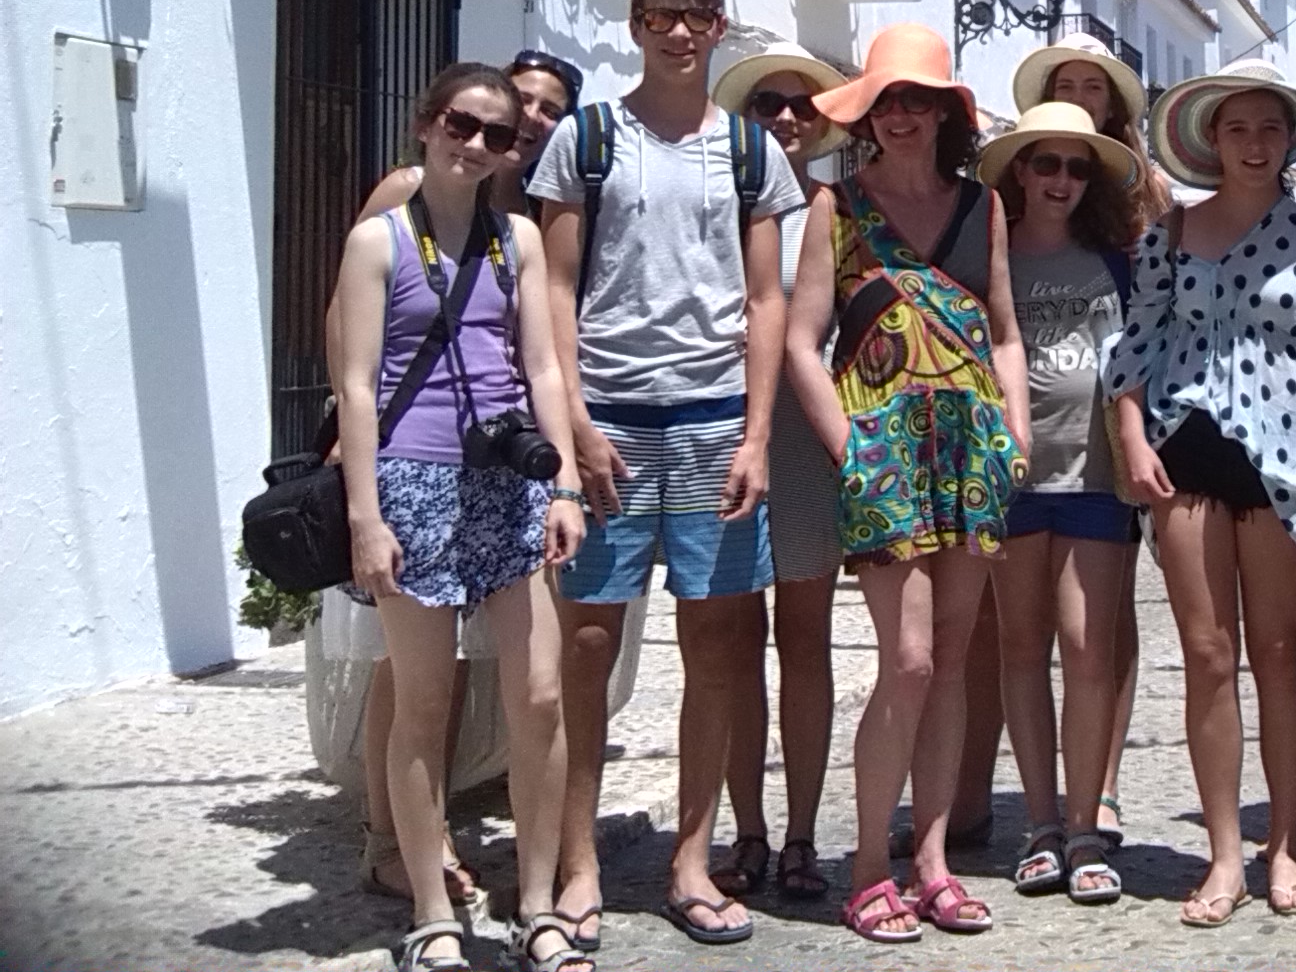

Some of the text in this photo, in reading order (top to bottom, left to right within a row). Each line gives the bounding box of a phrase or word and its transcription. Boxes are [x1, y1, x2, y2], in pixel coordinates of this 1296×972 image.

[423, 236, 438, 265] Nikon
[1029, 280, 1075, 298] live
[1014, 292, 1121, 325] ERYDAY
